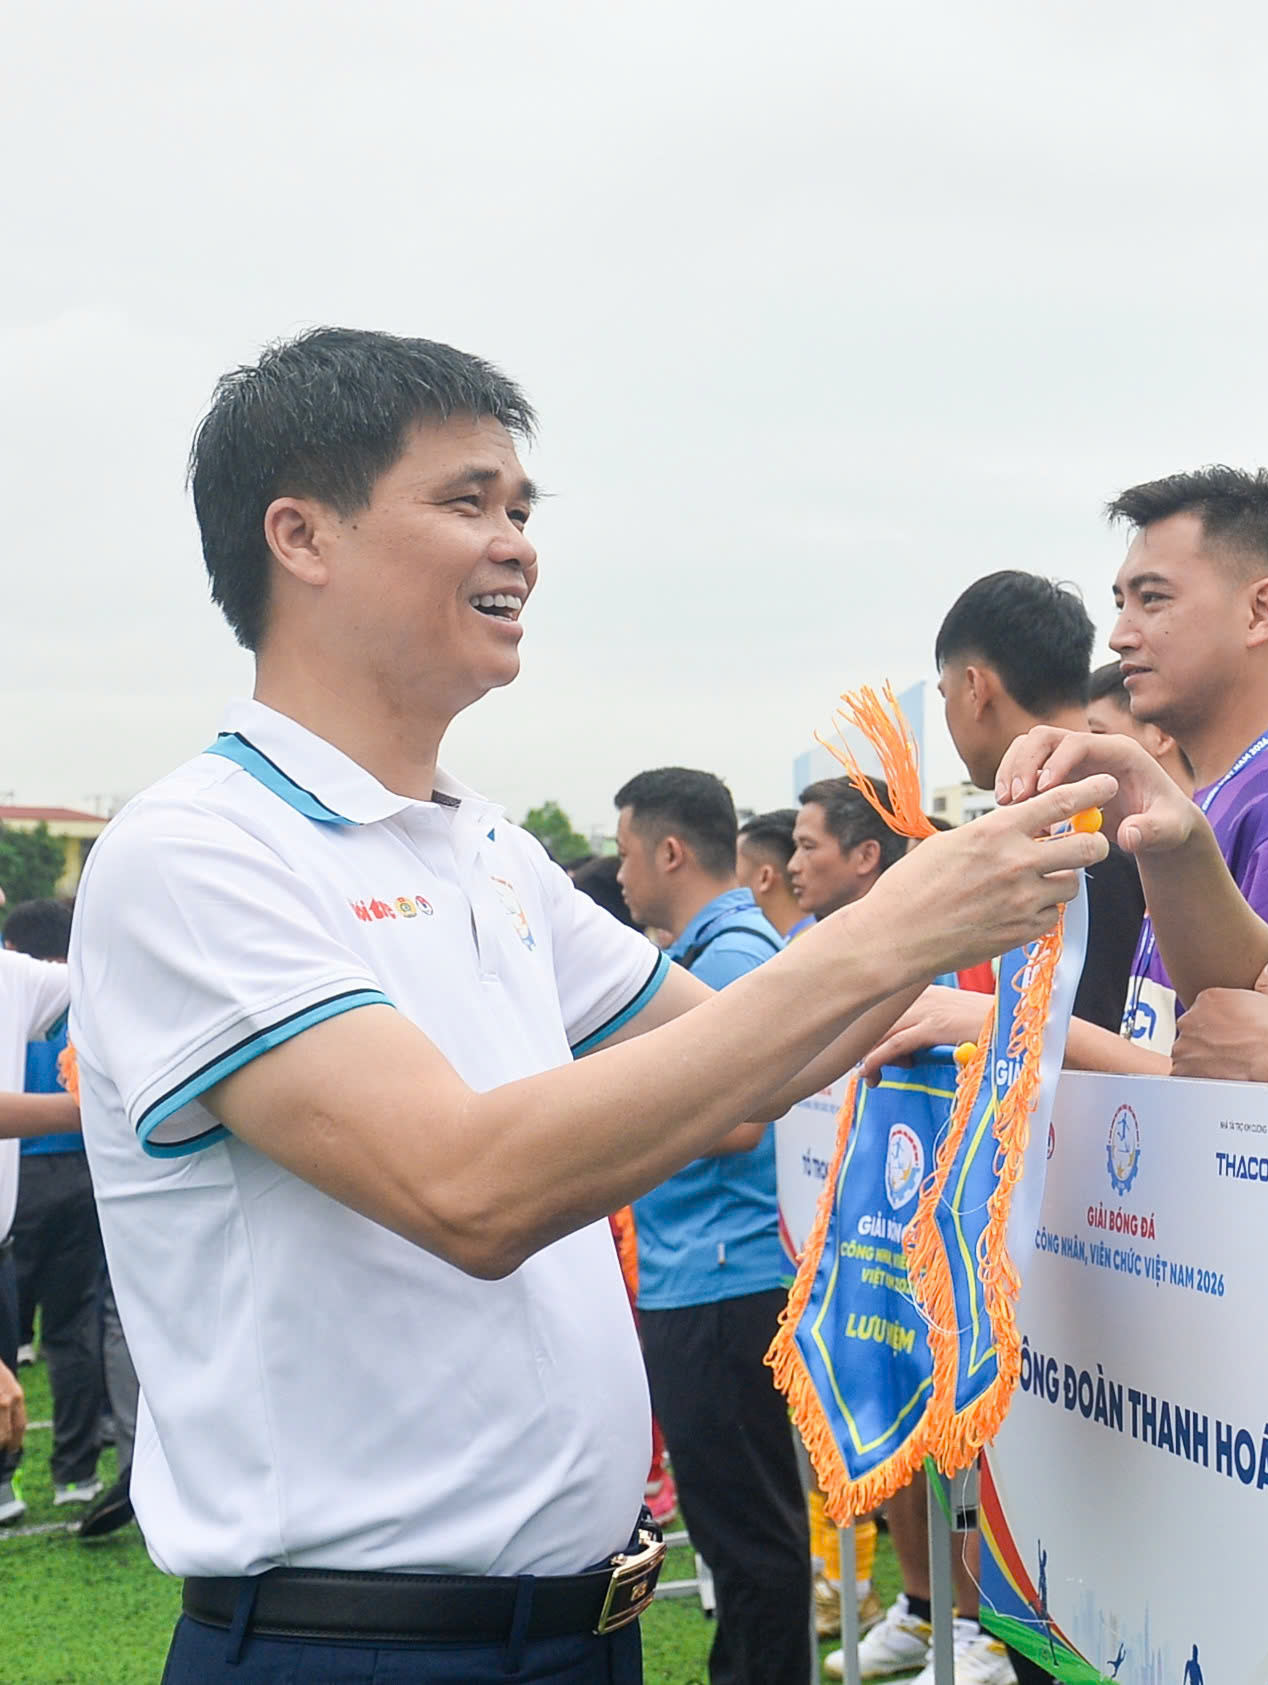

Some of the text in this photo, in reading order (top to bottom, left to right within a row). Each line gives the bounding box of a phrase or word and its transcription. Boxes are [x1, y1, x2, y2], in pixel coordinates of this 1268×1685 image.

[858, 1211, 886, 1238] GIẢI
[1087, 1202, 1156, 1240] GIẢI BÓNG ĐÁ
[840, 1240, 874, 1261] CÔNG
[1034, 1226, 1225, 1297] CÔNG NHÂN, VIÊN CHỨC VIỆT NAM 2026
[845, 1312, 887, 1343] LƯU
[1014, 1335, 1060, 1405] ÔNG
[1063, 1362, 1125, 1433] ĐOÀN
[1127, 1387, 1209, 1468] THANH
